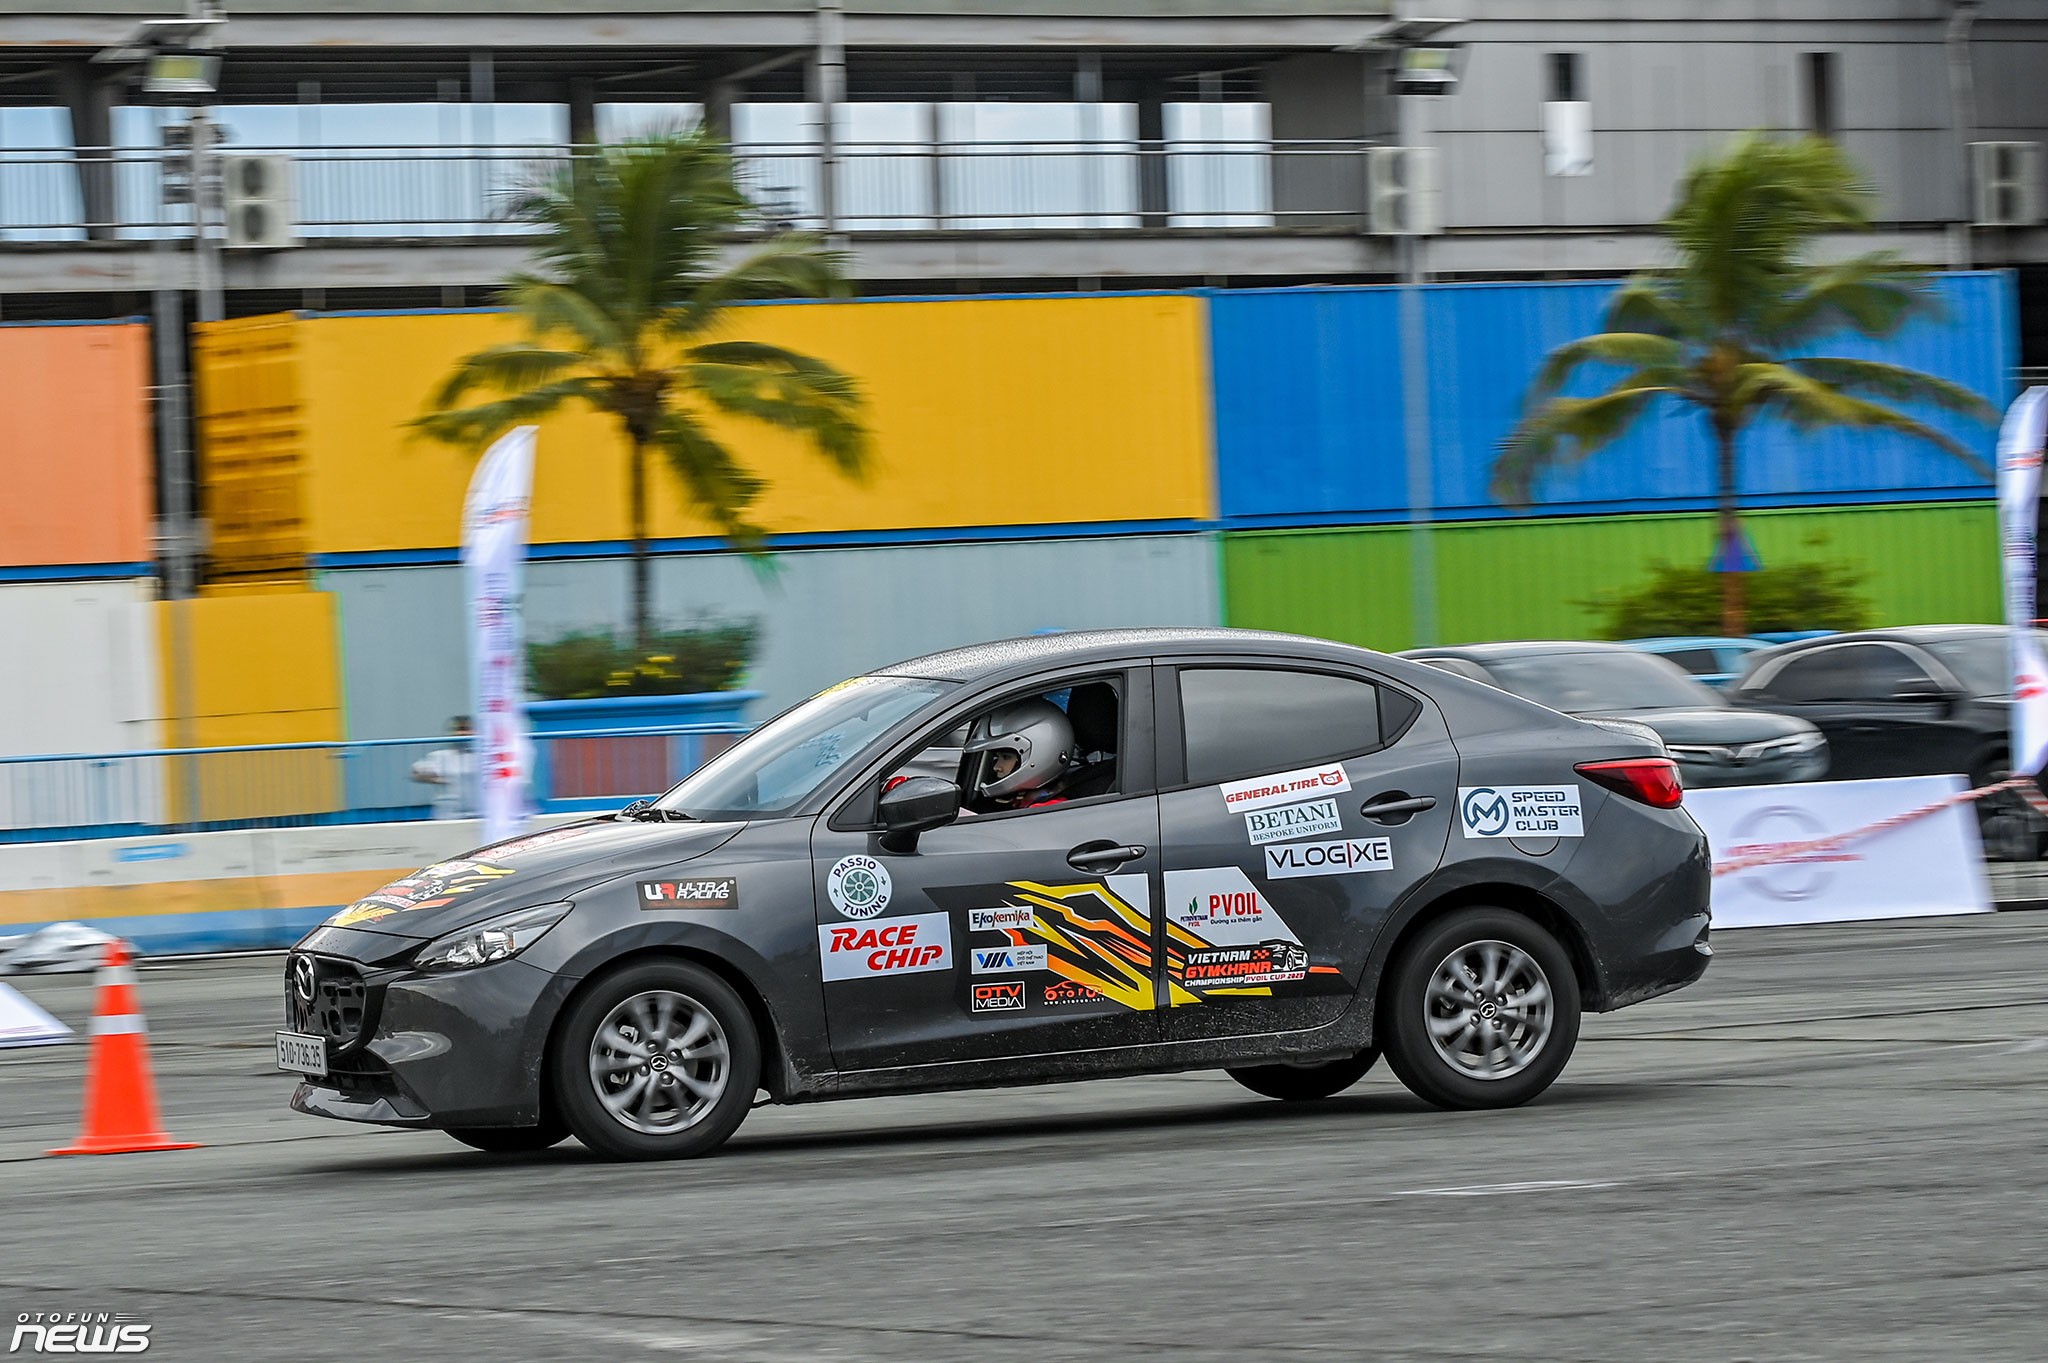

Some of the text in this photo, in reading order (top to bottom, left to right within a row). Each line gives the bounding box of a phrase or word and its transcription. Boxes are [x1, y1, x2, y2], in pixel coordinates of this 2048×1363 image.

[1225, 778, 1318, 803] GENERAL TIRE
[1511, 791, 1566, 802] SPEED
[1248, 802, 1336, 831] BETANI
[1513, 805, 1580, 817] MASTER
[1253, 821, 1338, 841] BESPOKE UNIFORM
[1516, 820, 1559, 831] CLUB
[833, 857, 877, 877] PASSIO
[676, 890, 730, 899] RACING
[678, 881, 729, 892] ULTRA
[842, 894, 887, 917] TUNING
[1209, 892, 1262, 917] PVOIL
[972, 910, 1030, 928] Ekokemika
[830, 924, 918, 952] RACE
[867, 945, 943, 970] CHIP
[1188, 949, 1251, 964] VIETNAM
[1186, 961, 1271, 979] GYMKHANA
[1184, 976, 1244, 987] CHAMPIONSHIP
[1245, 975, 1268, 983] PVOIL
[1270, 973, 1286, 981] CUP
[975, 985, 1021, 999] OTV
[976, 997, 1023, 1008] MEDIA
